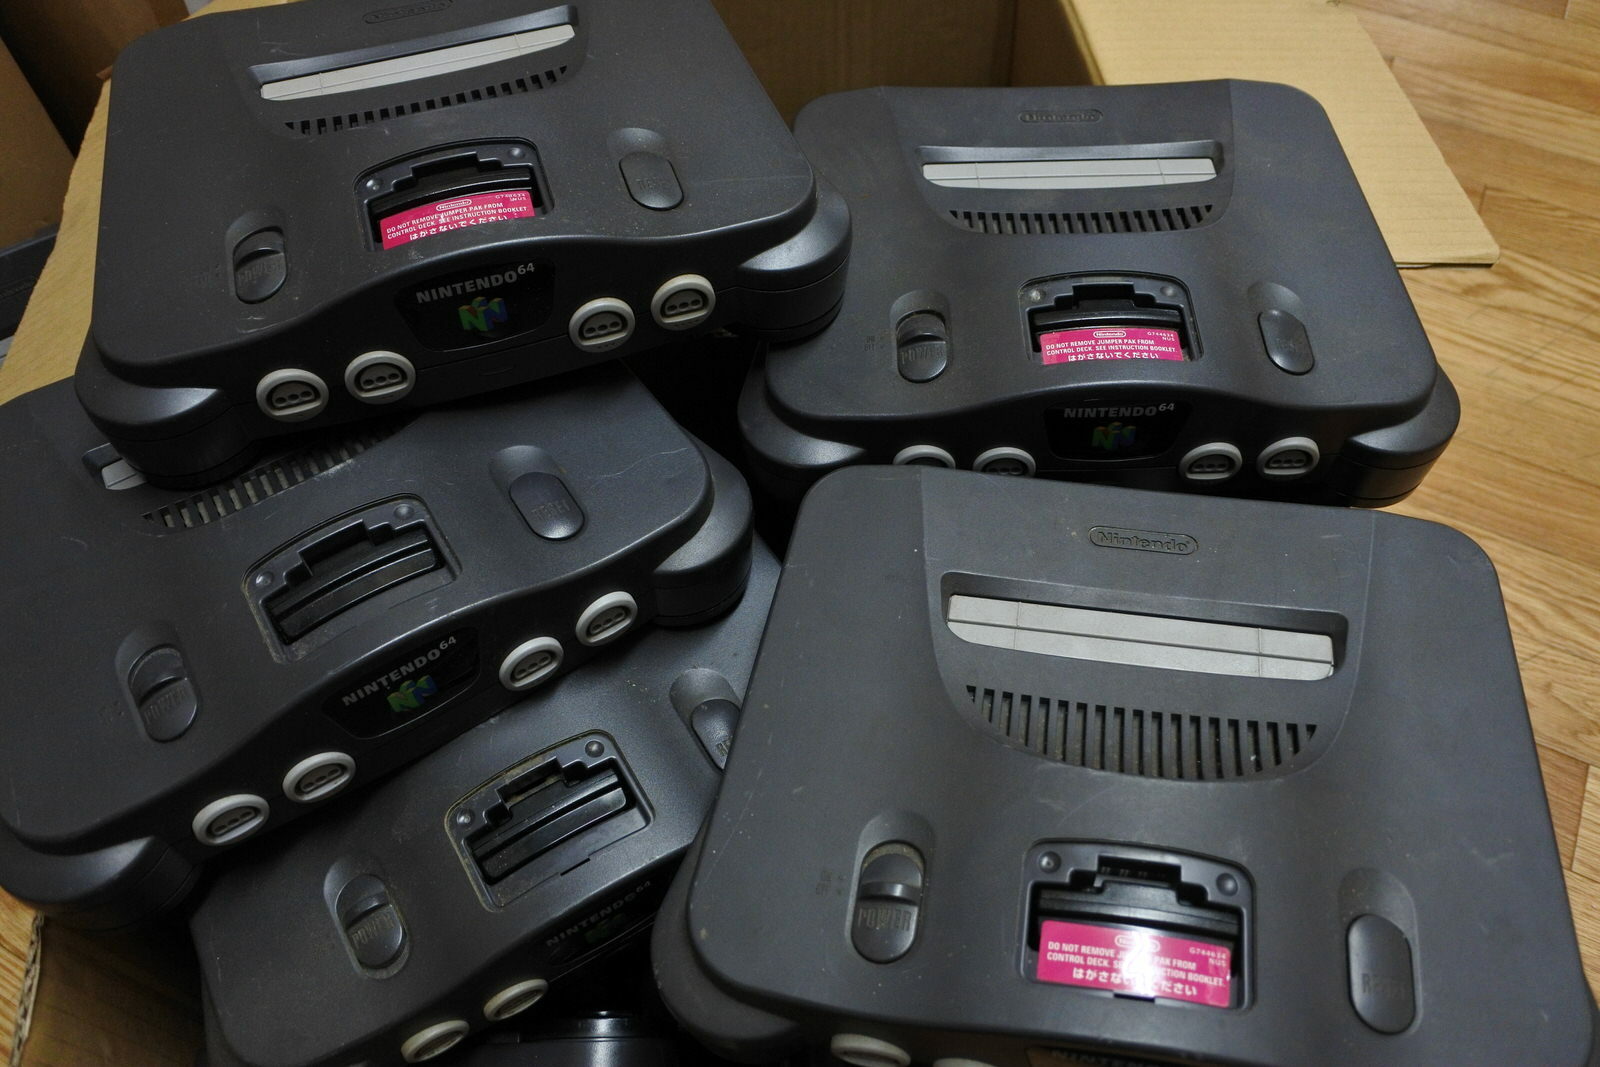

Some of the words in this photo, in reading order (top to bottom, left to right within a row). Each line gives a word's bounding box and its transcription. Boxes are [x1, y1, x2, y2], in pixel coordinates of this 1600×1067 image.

[386, 226, 396, 234] DO
[397, 221, 411, 230] NOT
[411, 214, 438, 225] REMOVE
[484, 202, 504, 210] FROM
[387, 226, 416, 239] CONTROL
[452, 208, 497, 221] INSTRUCTION
[416, 270, 518, 304] NINTENDO
[517, 262, 535, 275] 64
[1046, 348, 1075, 356] CONTROL
[1068, 352, 1159, 361] はがさないでください
[1063, 406, 1158, 418] NINTENDO
[1158, 402, 1176, 412] 64
[1097, 531, 1188, 552] Nintendo
[342, 648, 441, 707] NINTENDO
[440, 636, 457, 650] 64
[546, 892, 636, 947] NINTENDO
[857, 904, 912, 931] POWER
[1047, 941, 1060, 950] DO
[1061, 942, 1079, 952] NOT
[1080, 945, 1115, 958] REMOVE
[1047, 952, 1085, 965] CONTROL
[1172, 958, 1197, 970] FROM
